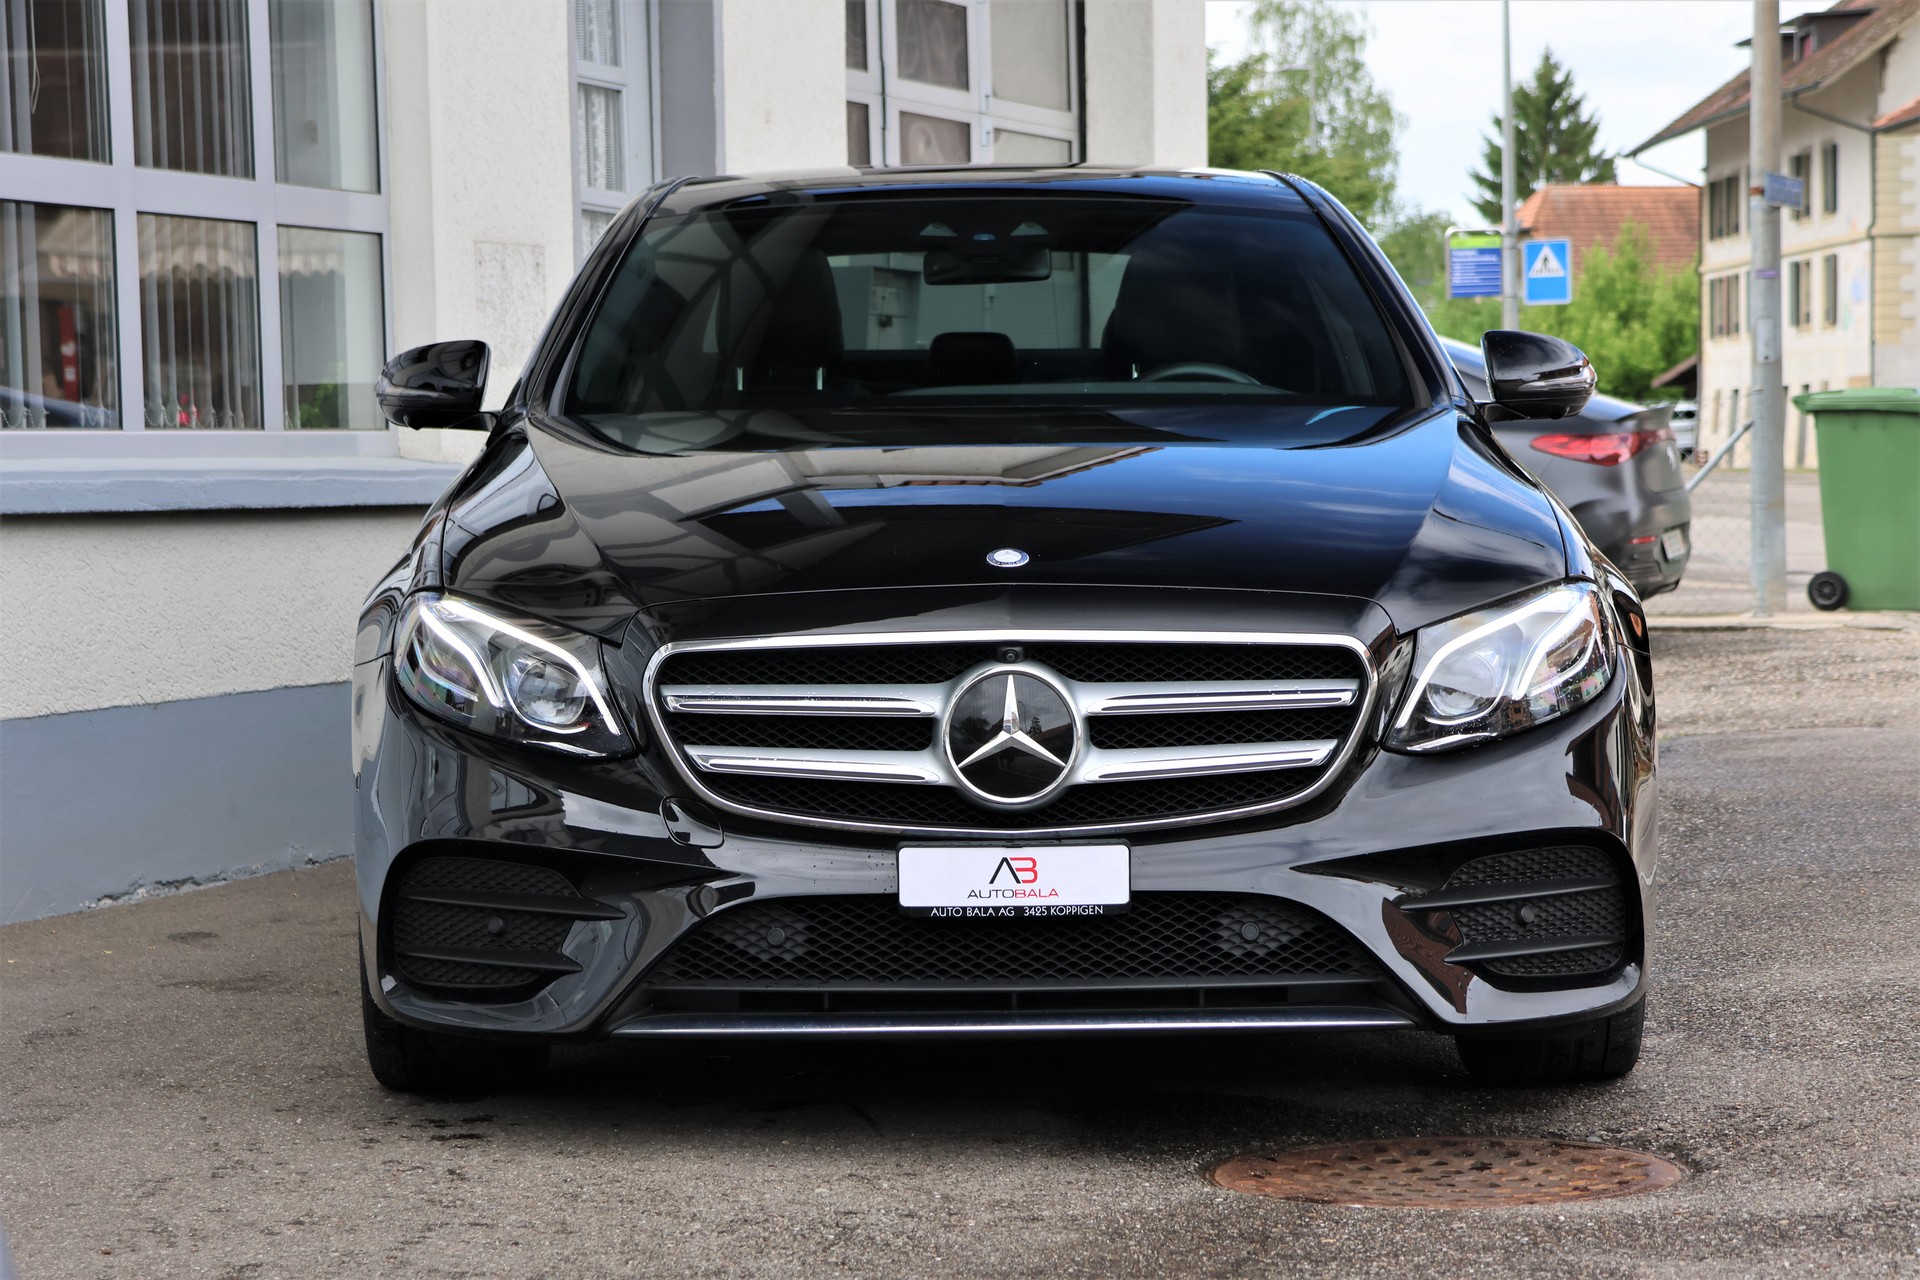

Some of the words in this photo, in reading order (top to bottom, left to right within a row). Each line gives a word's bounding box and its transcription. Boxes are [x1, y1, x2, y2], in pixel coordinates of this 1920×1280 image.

[989, 857, 1038, 884] AB
[967, 888, 1059, 899] AUTOBALA
[930, 907, 963, 917] AUTO
[966, 907, 996, 917] BALA
[998, 906, 1015, 917] AG
[1023, 906, 1048, 916] 3425
[1050, 904, 1104, 916] KOPPIGEN
